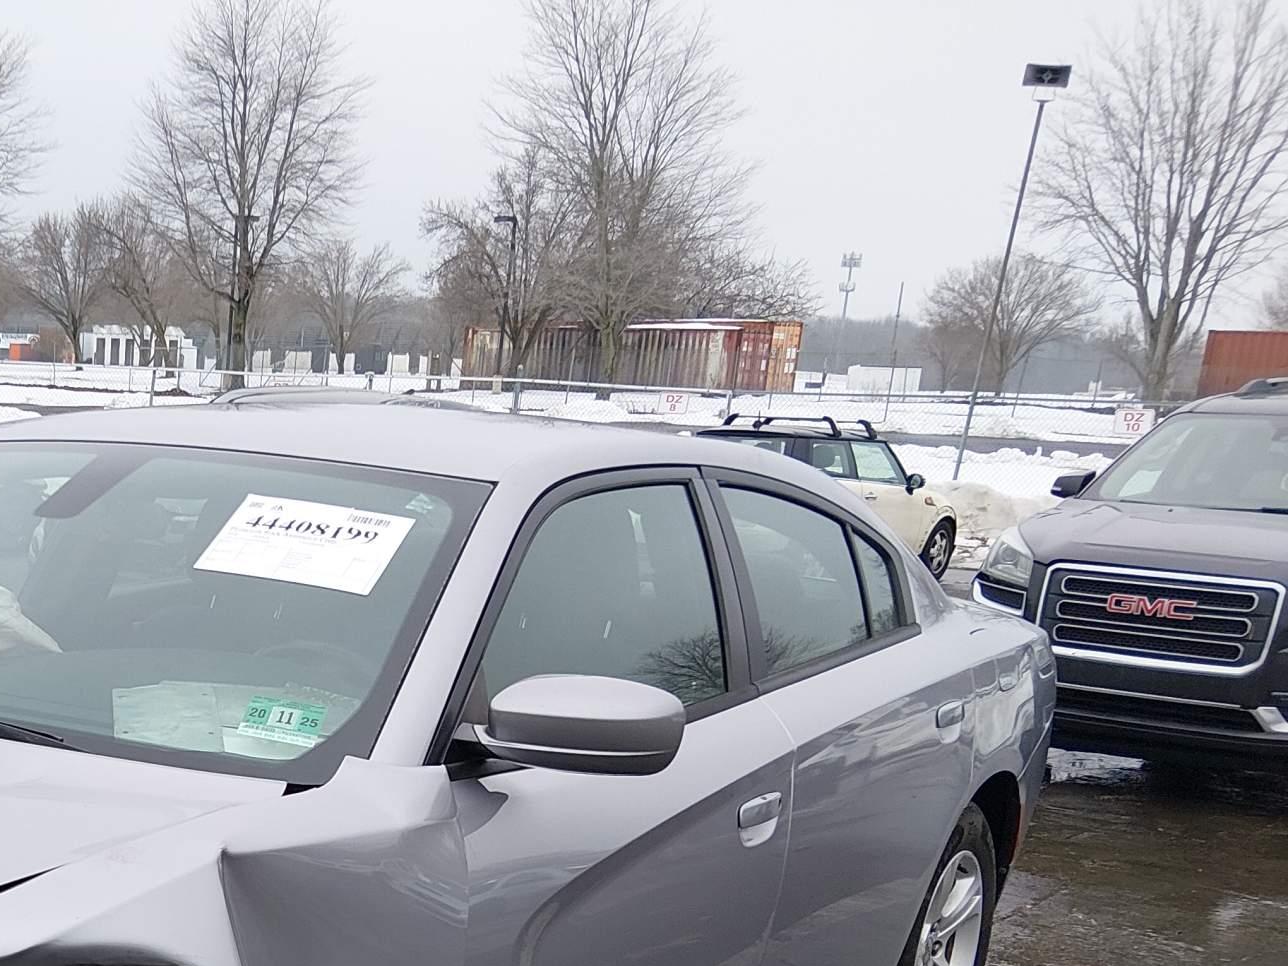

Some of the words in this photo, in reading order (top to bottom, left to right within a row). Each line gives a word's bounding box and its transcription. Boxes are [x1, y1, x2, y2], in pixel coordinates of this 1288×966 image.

[665, 395, 684, 404] DZ
[669, 404, 677, 412] 8
[1123, 412, 1146, 422] DZ
[1125, 422, 1141, 432] 10
[246, 515, 380, 544] 44408199
[1106, 593, 1198, 621] GMC
[248, 707, 267, 719] 20
[275, 710, 294, 725] 11
[299, 716, 320, 728] 25
